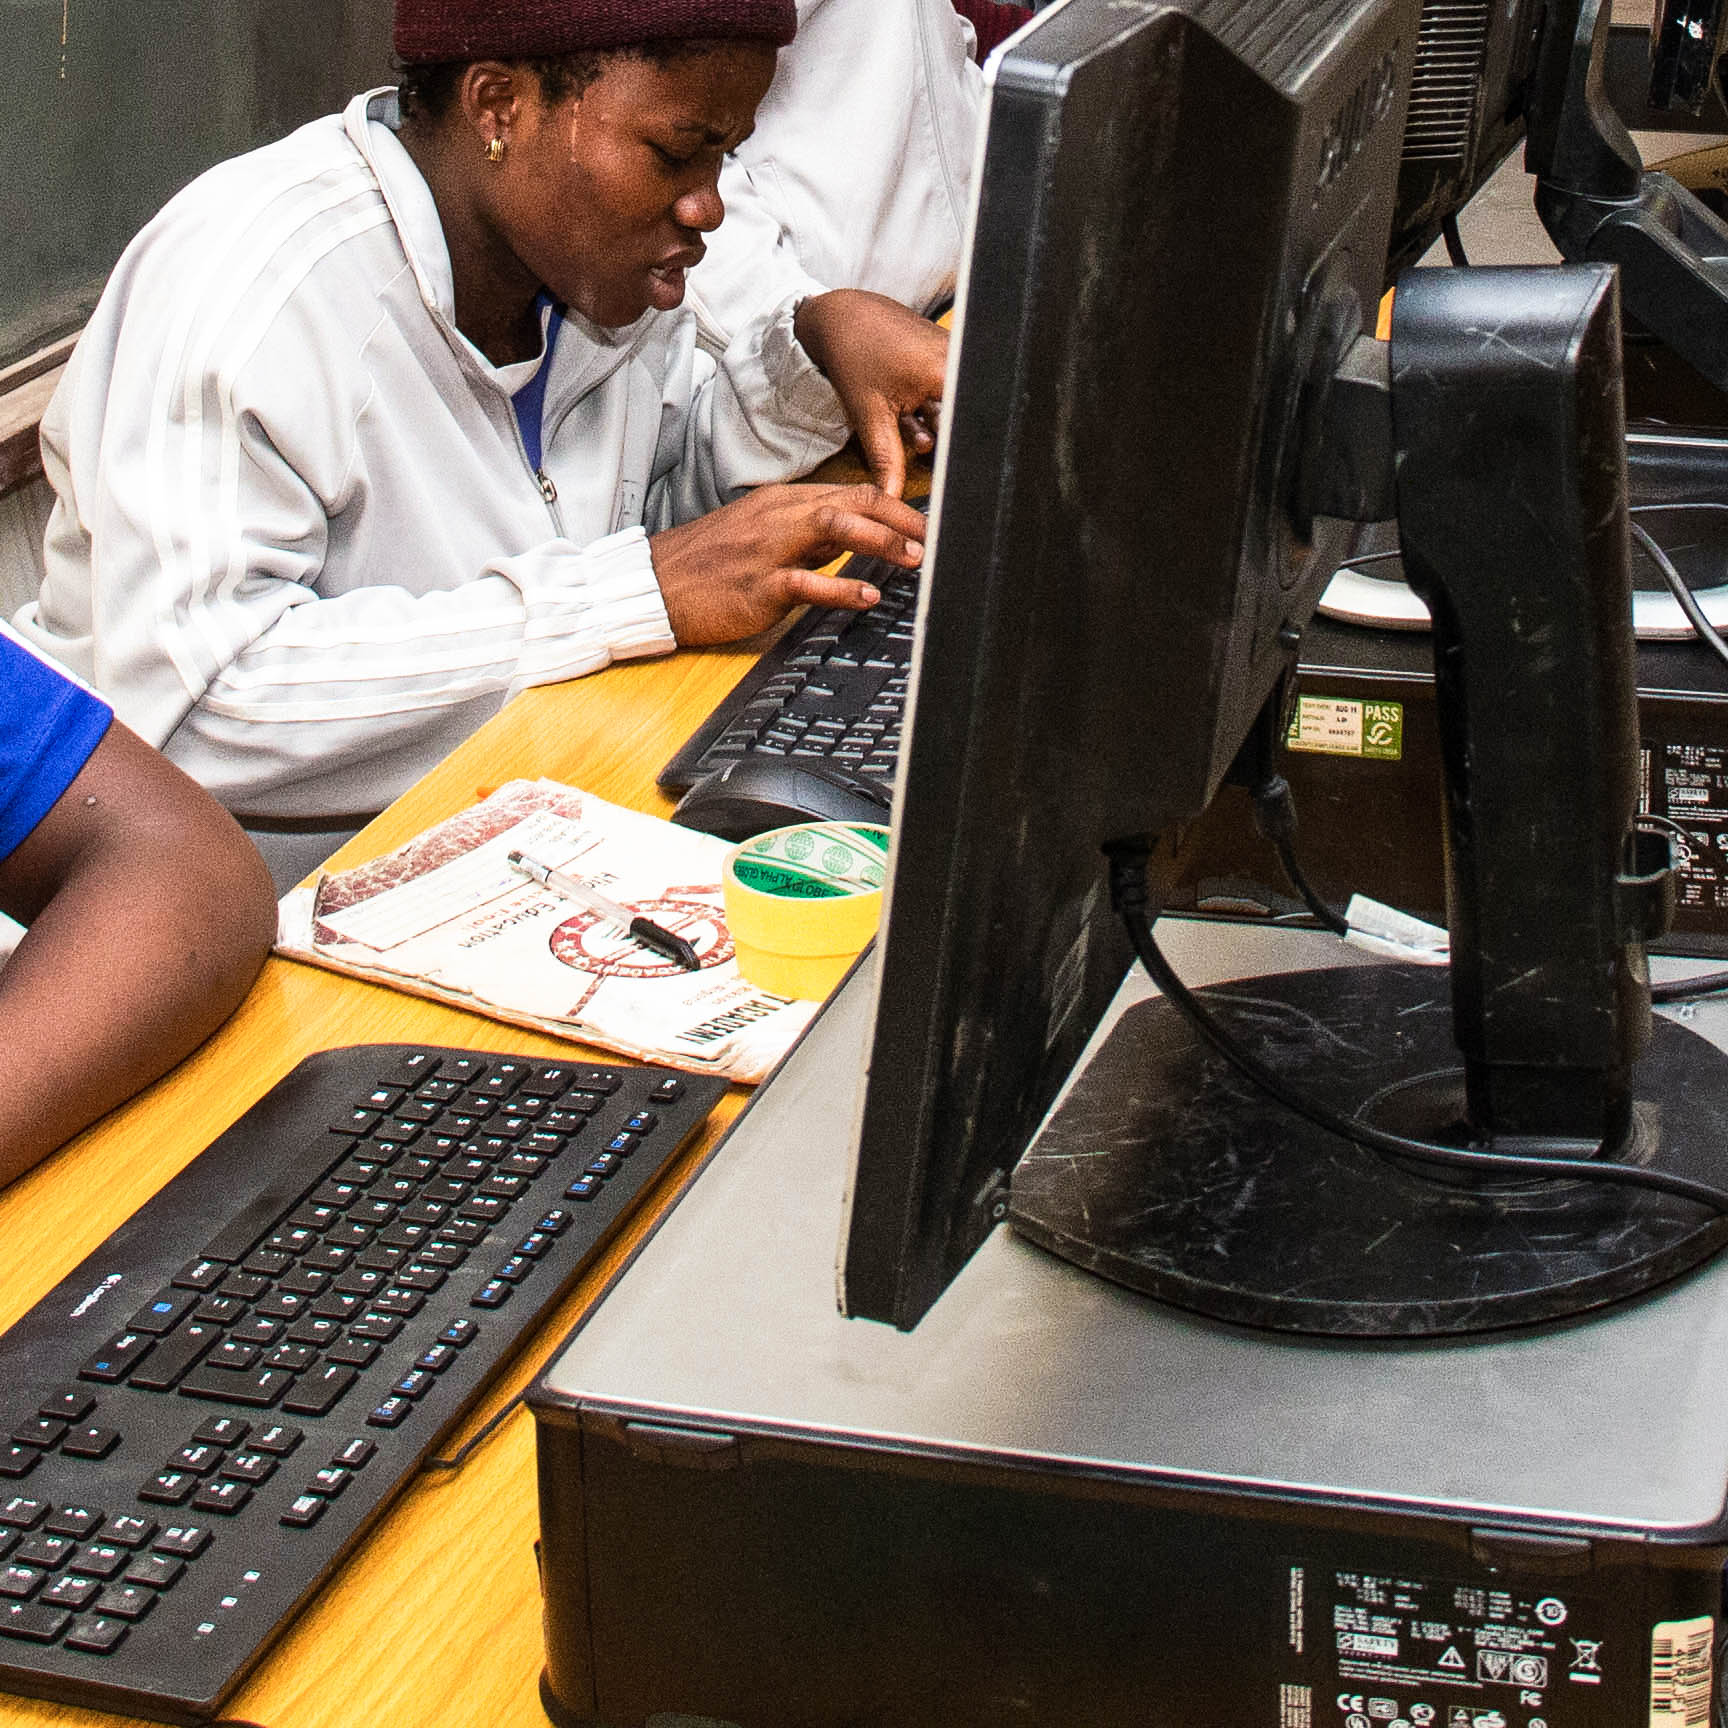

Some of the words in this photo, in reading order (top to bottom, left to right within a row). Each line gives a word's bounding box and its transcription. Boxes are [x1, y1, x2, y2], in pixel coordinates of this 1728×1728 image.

[1364, 704, 1400, 722] PASS
[674, 999, 781, 1046] ACADEMY
[69, 1280, 114, 1317] Logitech
